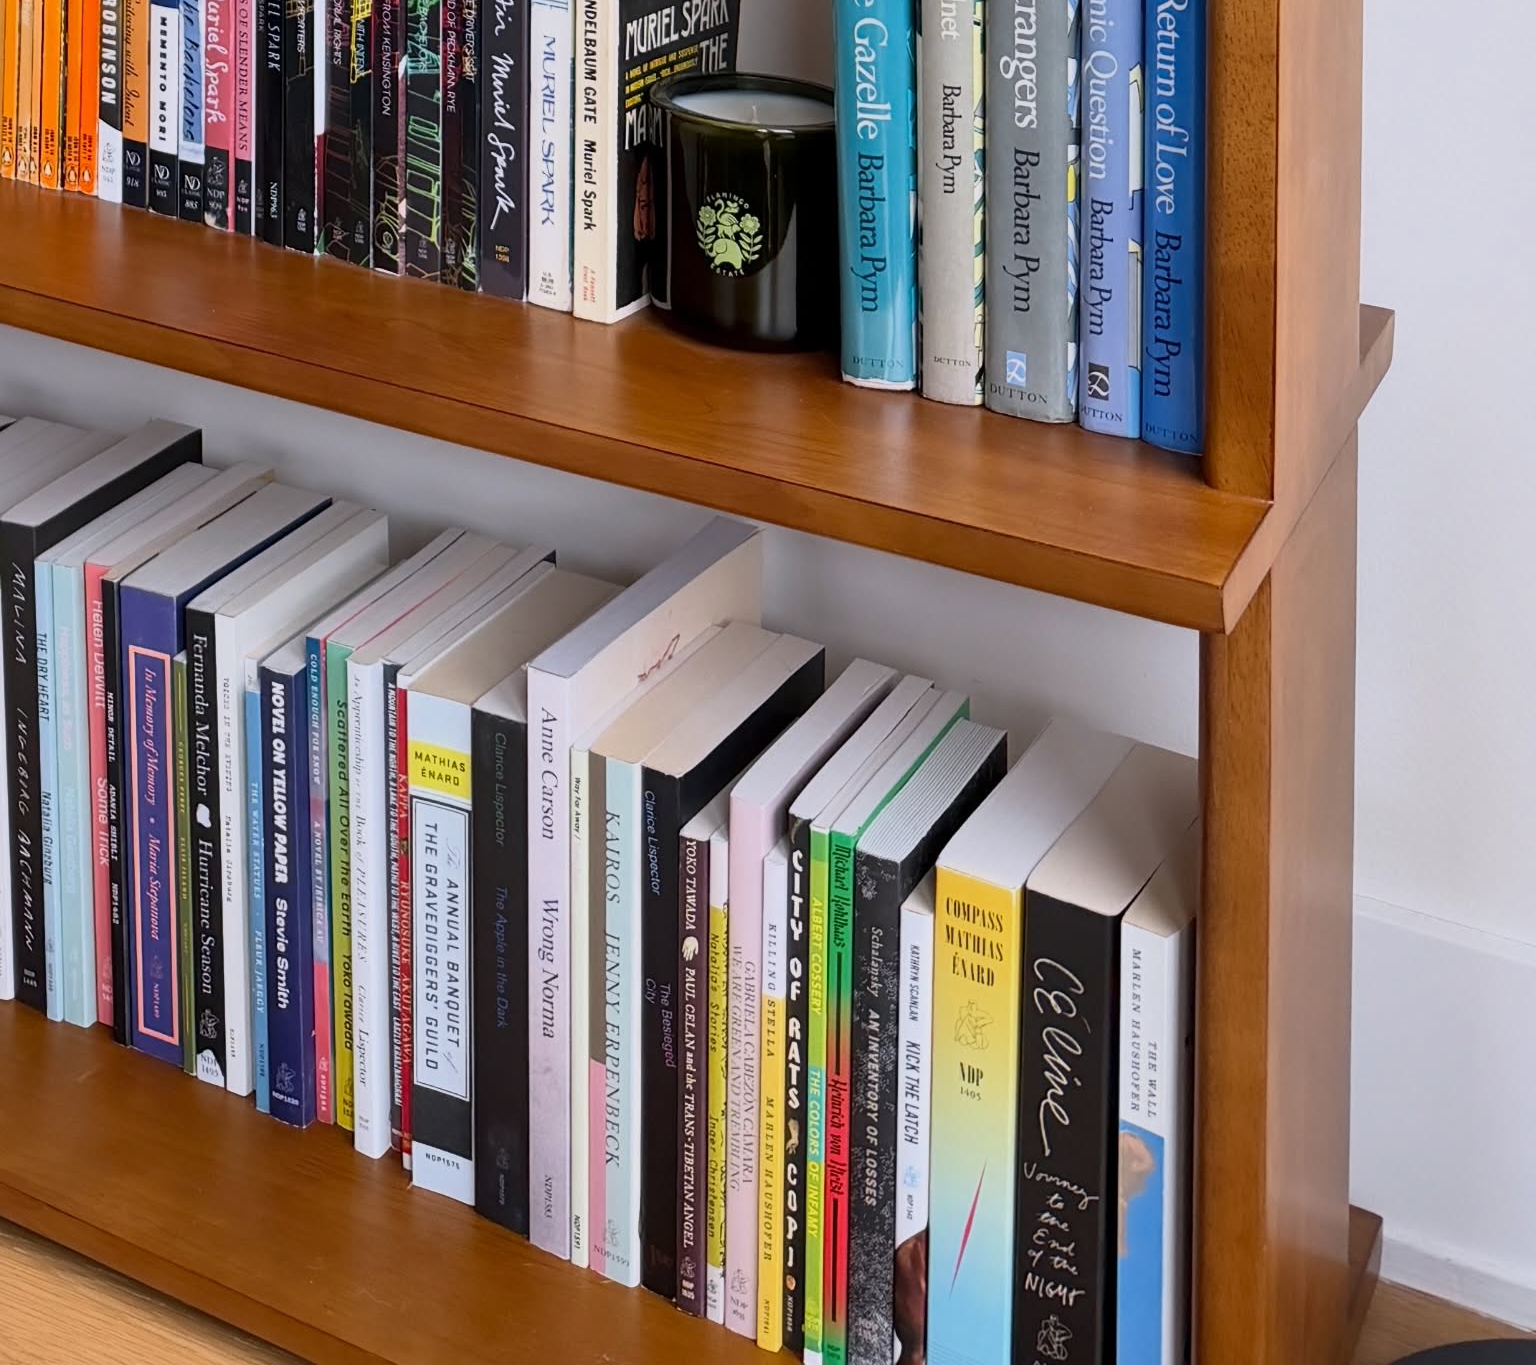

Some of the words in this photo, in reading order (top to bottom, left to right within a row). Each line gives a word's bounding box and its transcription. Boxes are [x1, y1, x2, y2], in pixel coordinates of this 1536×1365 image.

[584, 87, 597, 124] GATE
[853, 17, 890, 139] Gazelle
[1156, 103, 1190, 135] of
[583, 140, 597, 186] Muriel
[1155, 144, 1187, 214] Love
[580, 191, 597, 230] Spark
[857, 153, 882, 249] Barbara
[852, 254, 885, 312] Pym
[272, 682, 286, 734] NOVEL
[540, 709, 559, 763] Anne
[272, 739, 286, 764] ON
[272, 769, 287, 829] YELLOW
[540, 770, 559, 840] Carson
[273, 834, 288, 883] PAPER
[424, 822, 439, 856] THE
[605, 810, 621, 903] KAIROS
[444, 878, 460, 952] ANNUAL
[538, 899, 560, 963] Wrong
[605, 932, 621, 1012] JENNY
[445, 961, 461, 1047] BANQUET
[541, 969, 560, 1038] Norma
[424, 1016, 440, 1069] GUILD
[606, 1021, 621, 1167] ERPENBECK
